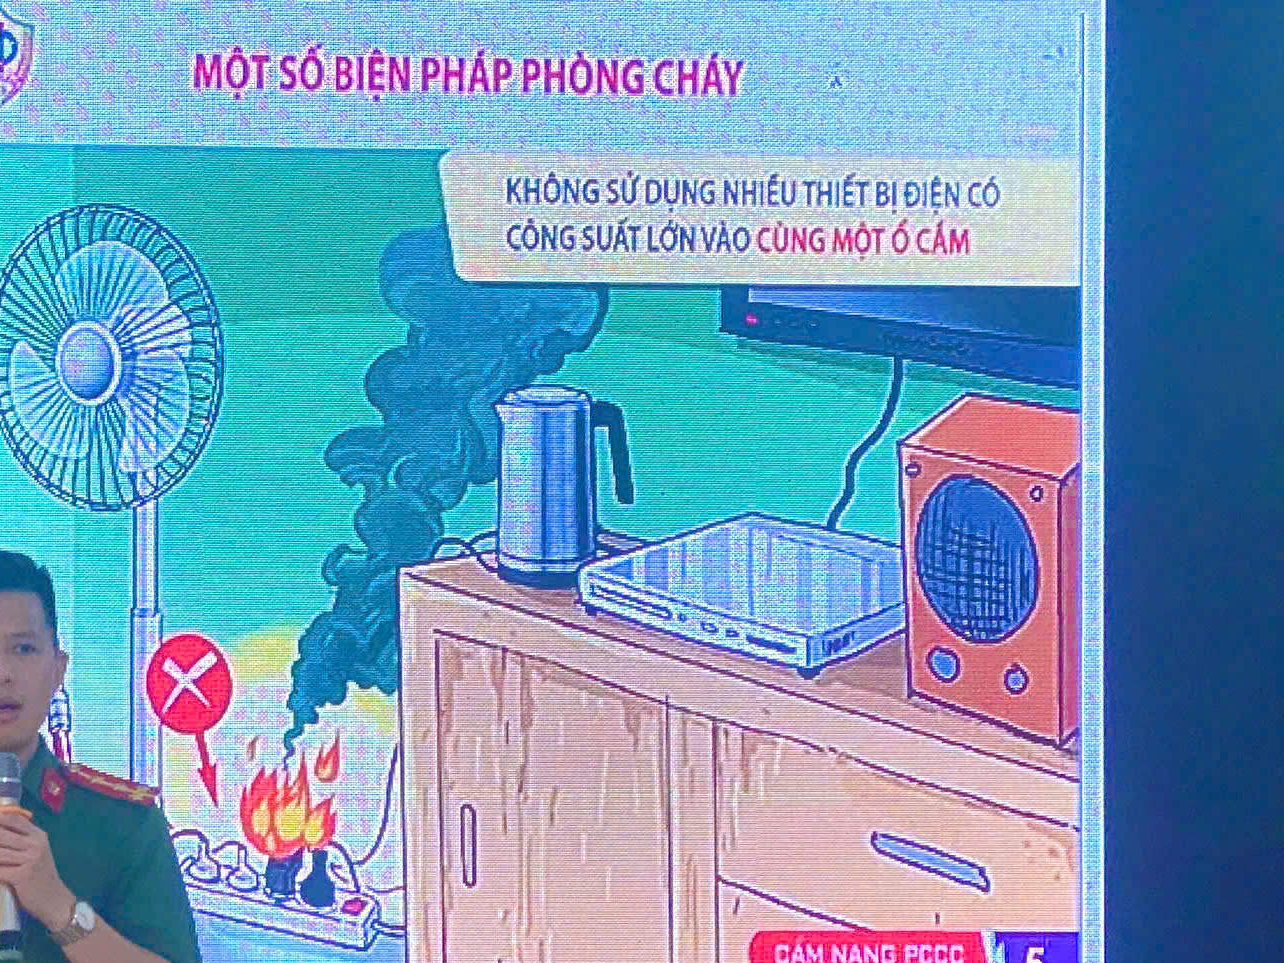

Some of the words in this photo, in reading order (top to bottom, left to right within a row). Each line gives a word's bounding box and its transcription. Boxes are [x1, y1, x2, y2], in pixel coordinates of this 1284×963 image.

[193, 46, 270, 101] MỘT
[279, 42, 325, 90] SỐ
[334, 46, 411, 102] BIỆN
[421, 49, 514, 95] PHÁP
[523, 51, 645, 97] PHÒNG
[654, 51, 744, 98] CHÁY
[506, 172, 601, 205] KHÔNG
[606, 169, 639, 205] SỬ
[645, 178, 714, 213] DỤNG
[722, 172, 796, 207] NHIỀU
[803, 173, 870, 207] THIẾT
[876, 179, 898, 215] BỊ
[902, 175, 960, 215] ĐIỆN
[968, 175, 1001, 206] CÓ
[506, 219, 575, 252] CÔNG
[582, 217, 639, 252] SUẤT
[646, 219, 697, 252] LỚN
[701, 219, 749, 253] VÀO
[757, 220, 826, 255] CÙNG
[832, 221, 885, 262] MỘT
